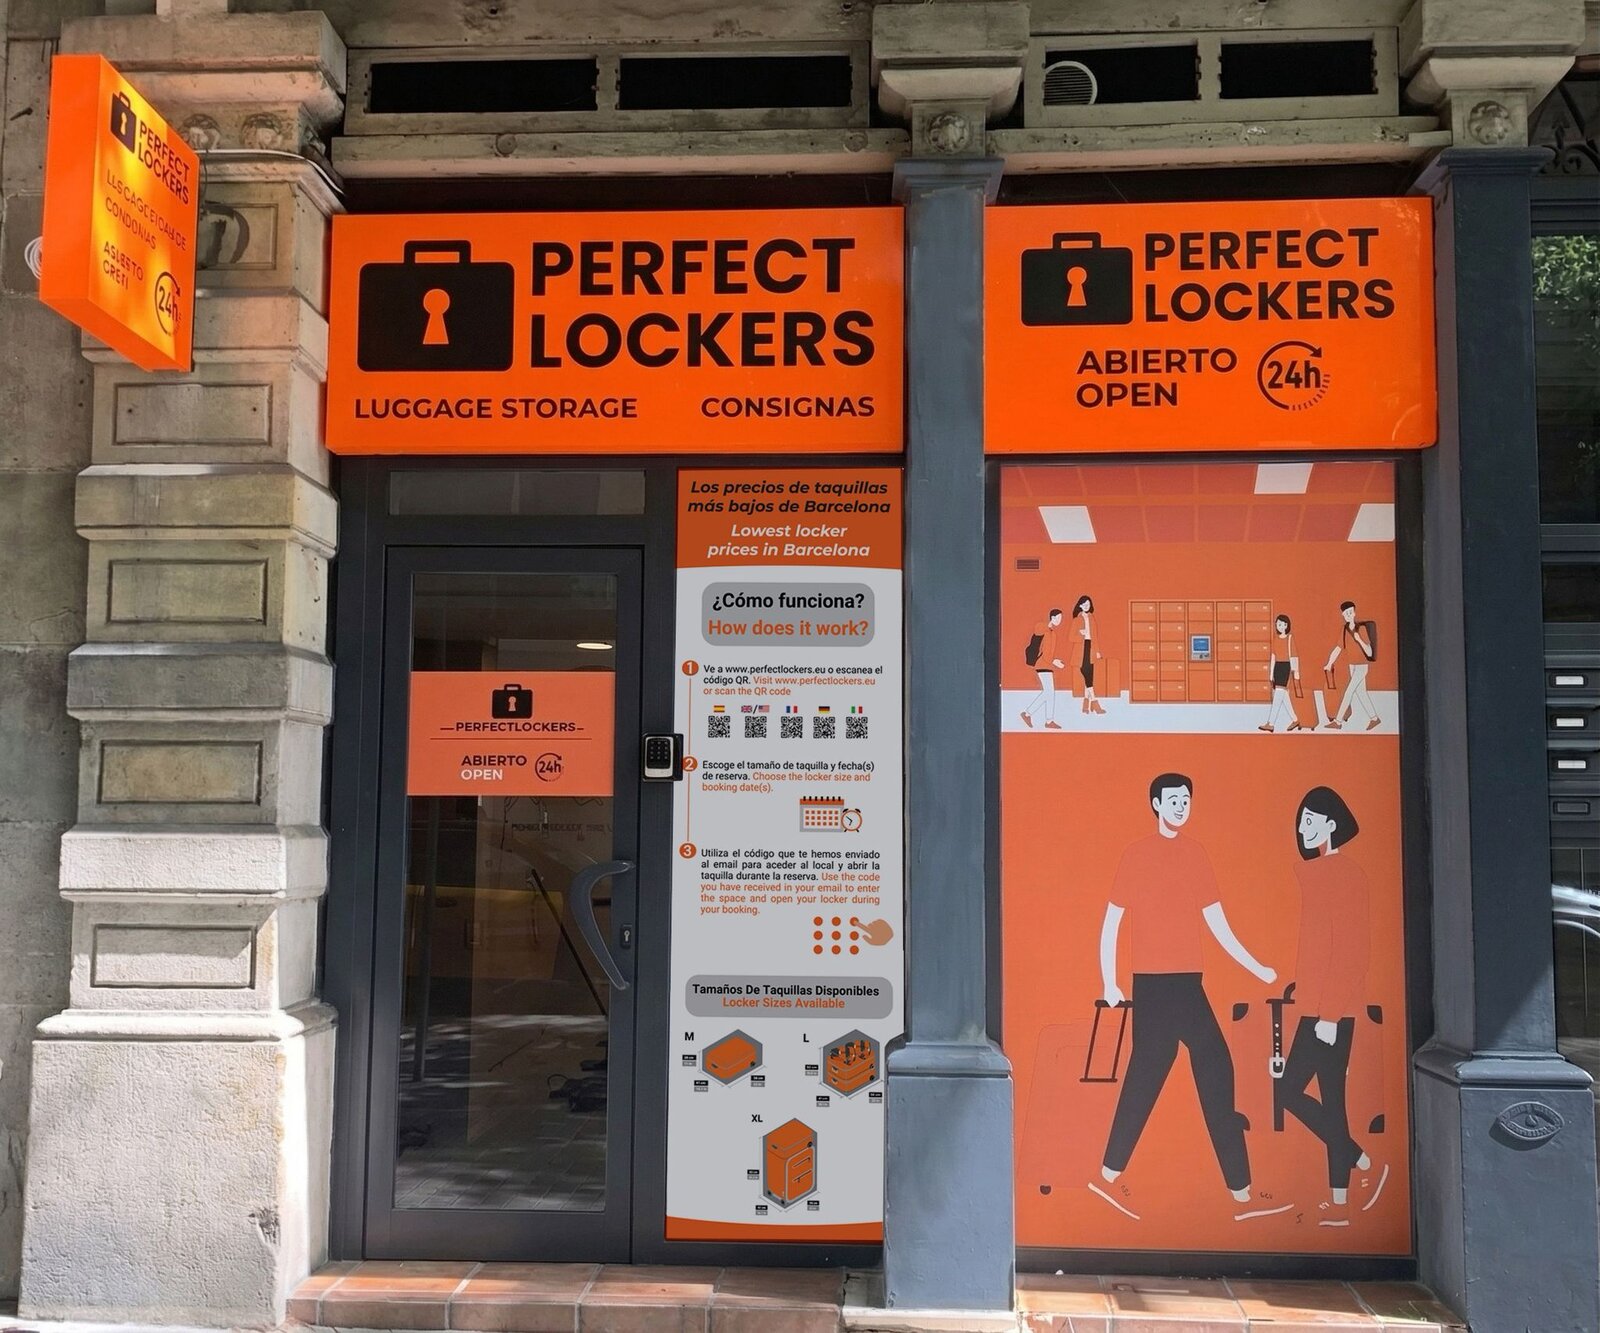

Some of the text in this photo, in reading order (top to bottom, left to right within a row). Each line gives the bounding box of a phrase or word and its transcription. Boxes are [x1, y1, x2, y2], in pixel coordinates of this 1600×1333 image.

[139, 120, 190, 182] PERFECT
[138, 143, 189, 205] LOCKERS
[1144, 224, 1379, 273] PERFECT
[531, 237, 855, 296] PERFECT
[159, 286, 178, 321] 24h
[1144, 279, 1395, 324] LOCKERS
[530, 310, 875, 368] LOCKERS
[1075, 348, 1239, 376] ABIERTO
[1267, 359, 1321, 390] 24h
[1076, 382, 1179, 409] OPEN
[354, 397, 637, 419] LUGGAGE STORAGE
[700, 396, 875, 418] CONSIGNAS
[691, 480, 888, 497] Los precios de taquillas
[688, 499, 891, 515] más bajos de Barcelona
[731, 524, 848, 537] Lowest locker
[707, 542, 870, 558] prices in Barcelona
[712, 592, 864, 611] ¿Cómo funciona?
[708, 619, 868, 636] How does it work?
[703, 665, 715, 673] Ve
[725, 664, 826, 675] www.perfectlockers.eu
[875, 666, 883, 674] el
[703, 675, 734, 686] código
[735, 675, 751, 685] QR.
[775, 676, 875, 686] www.perfectlockers.eu
[714, 686, 736, 695] scan
[738, 687, 752, 695] the
[754, 687, 767, 696] QR
[769, 687, 791, 695] code
[456, 721, 576, 732] PERFECTLOCKERS
[461, 754, 528, 767] ABIERTO
[538, 760, 561, 773] 24h
[702, 760, 874, 772] Escoge el tamaño de taquilla y fecha(s)
[461, 769, 502, 781] OPEN
[702, 772, 713, 780] de
[715, 772, 750, 780] reserva.
[753, 772, 786, 780] Choose
[702, 782, 775, 793] booking date(s).
[701, 849, 880, 860] Utiliza el código que te hemos enviado
[701, 860, 880, 871] al email para aceder al local y abrir la
[701, 871, 733, 881] taquilla
[736, 871, 770, 880] durante
[773, 872, 781, 880] la
[783, 873, 818, 881] reserva.
[841, 873, 855, 881] the
[858, 873, 880, 881] code
[700, 884, 717, 893] you
[720, 882, 741, 891] have
[744, 883, 781, 893] received
[784, 883, 792, 891] in
[795, 883, 815, 893] your
[817, 883, 842, 893] email
[857, 883, 880, 893] enter
[701, 894, 880, 905] the space and open your locker during
[700, 905, 760, 916] your booking.
[692, 984, 879, 997] Tamaños De Taquillas Disponibles
[722, 997, 847, 1009] Locker Sizes Available
[685, 1032, 694, 1041] M
[803, 1033, 809, 1043] L
[751, 1114, 763, 1123] XL
